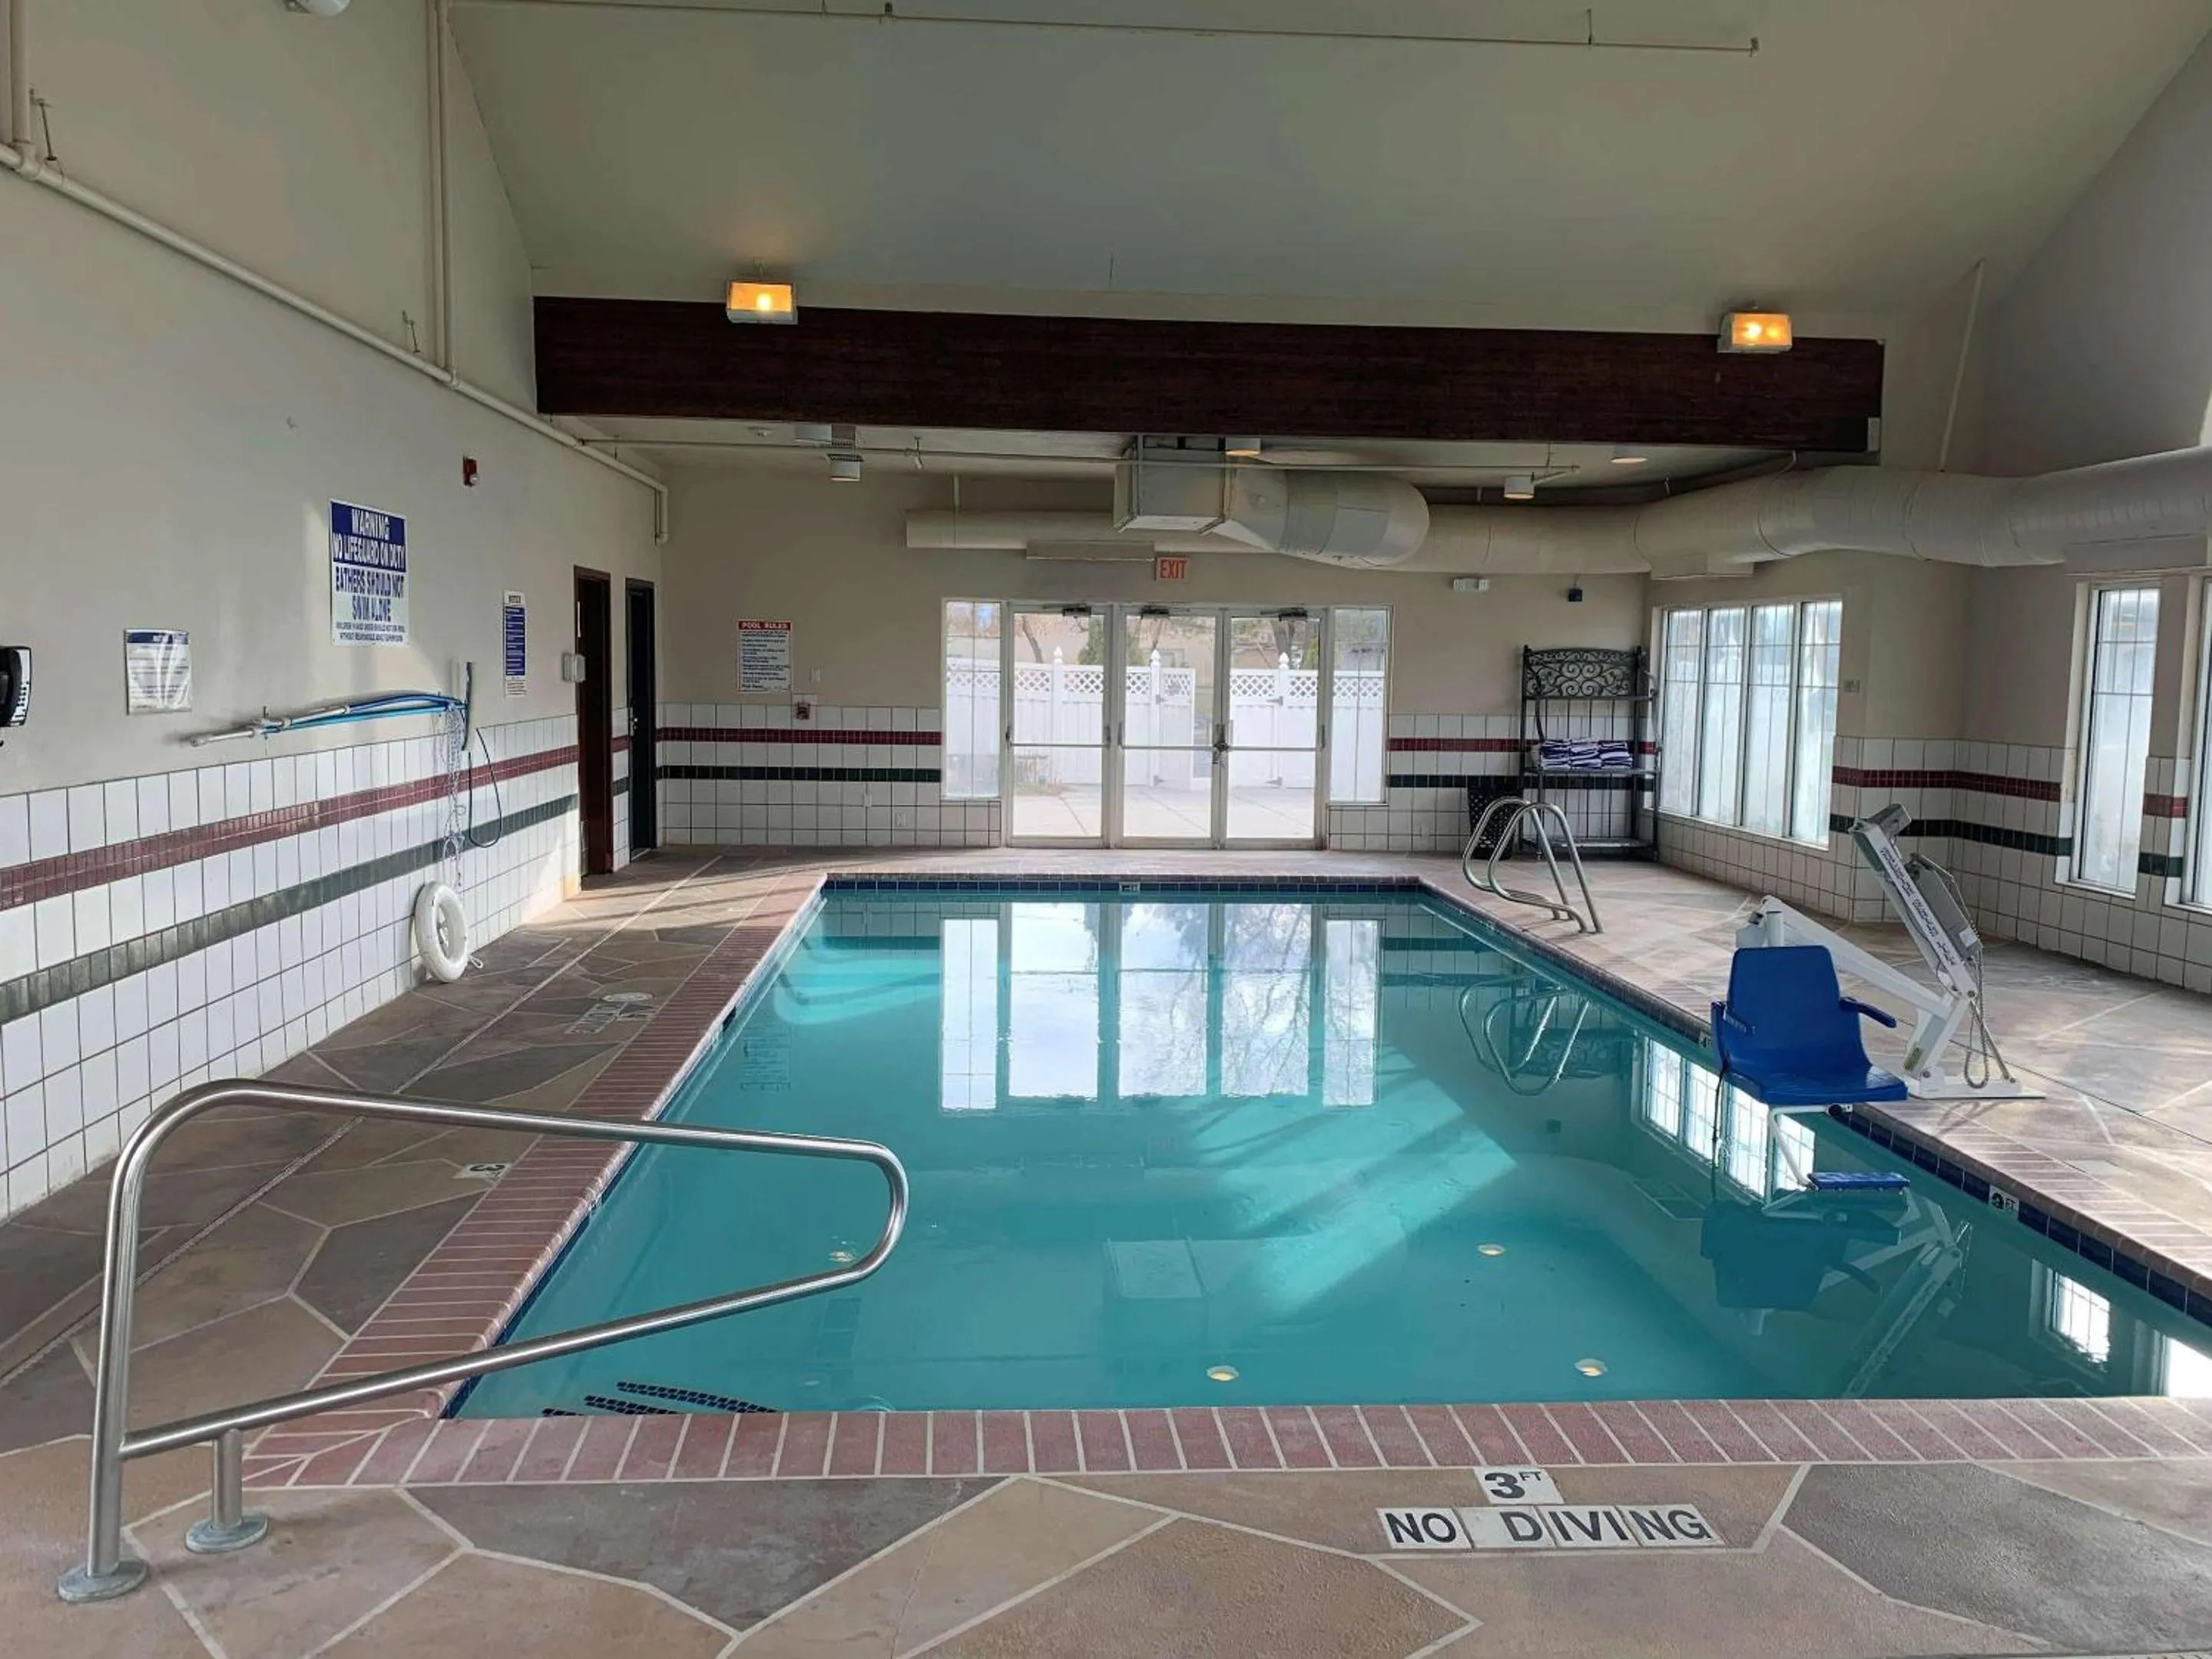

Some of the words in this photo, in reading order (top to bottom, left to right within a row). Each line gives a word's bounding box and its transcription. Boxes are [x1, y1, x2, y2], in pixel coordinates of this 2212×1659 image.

[352, 508, 390, 541] WARNING
[343, 534, 379, 565] LIFEGUARD
[1161, 560, 1187, 579] EXIT
[1484, 1472, 1525, 1499] 3
[1518, 1472, 1541, 1482] FT
[1385, 1512, 1457, 1544] NO
[1500, 1509, 1713, 1543] DIVING
